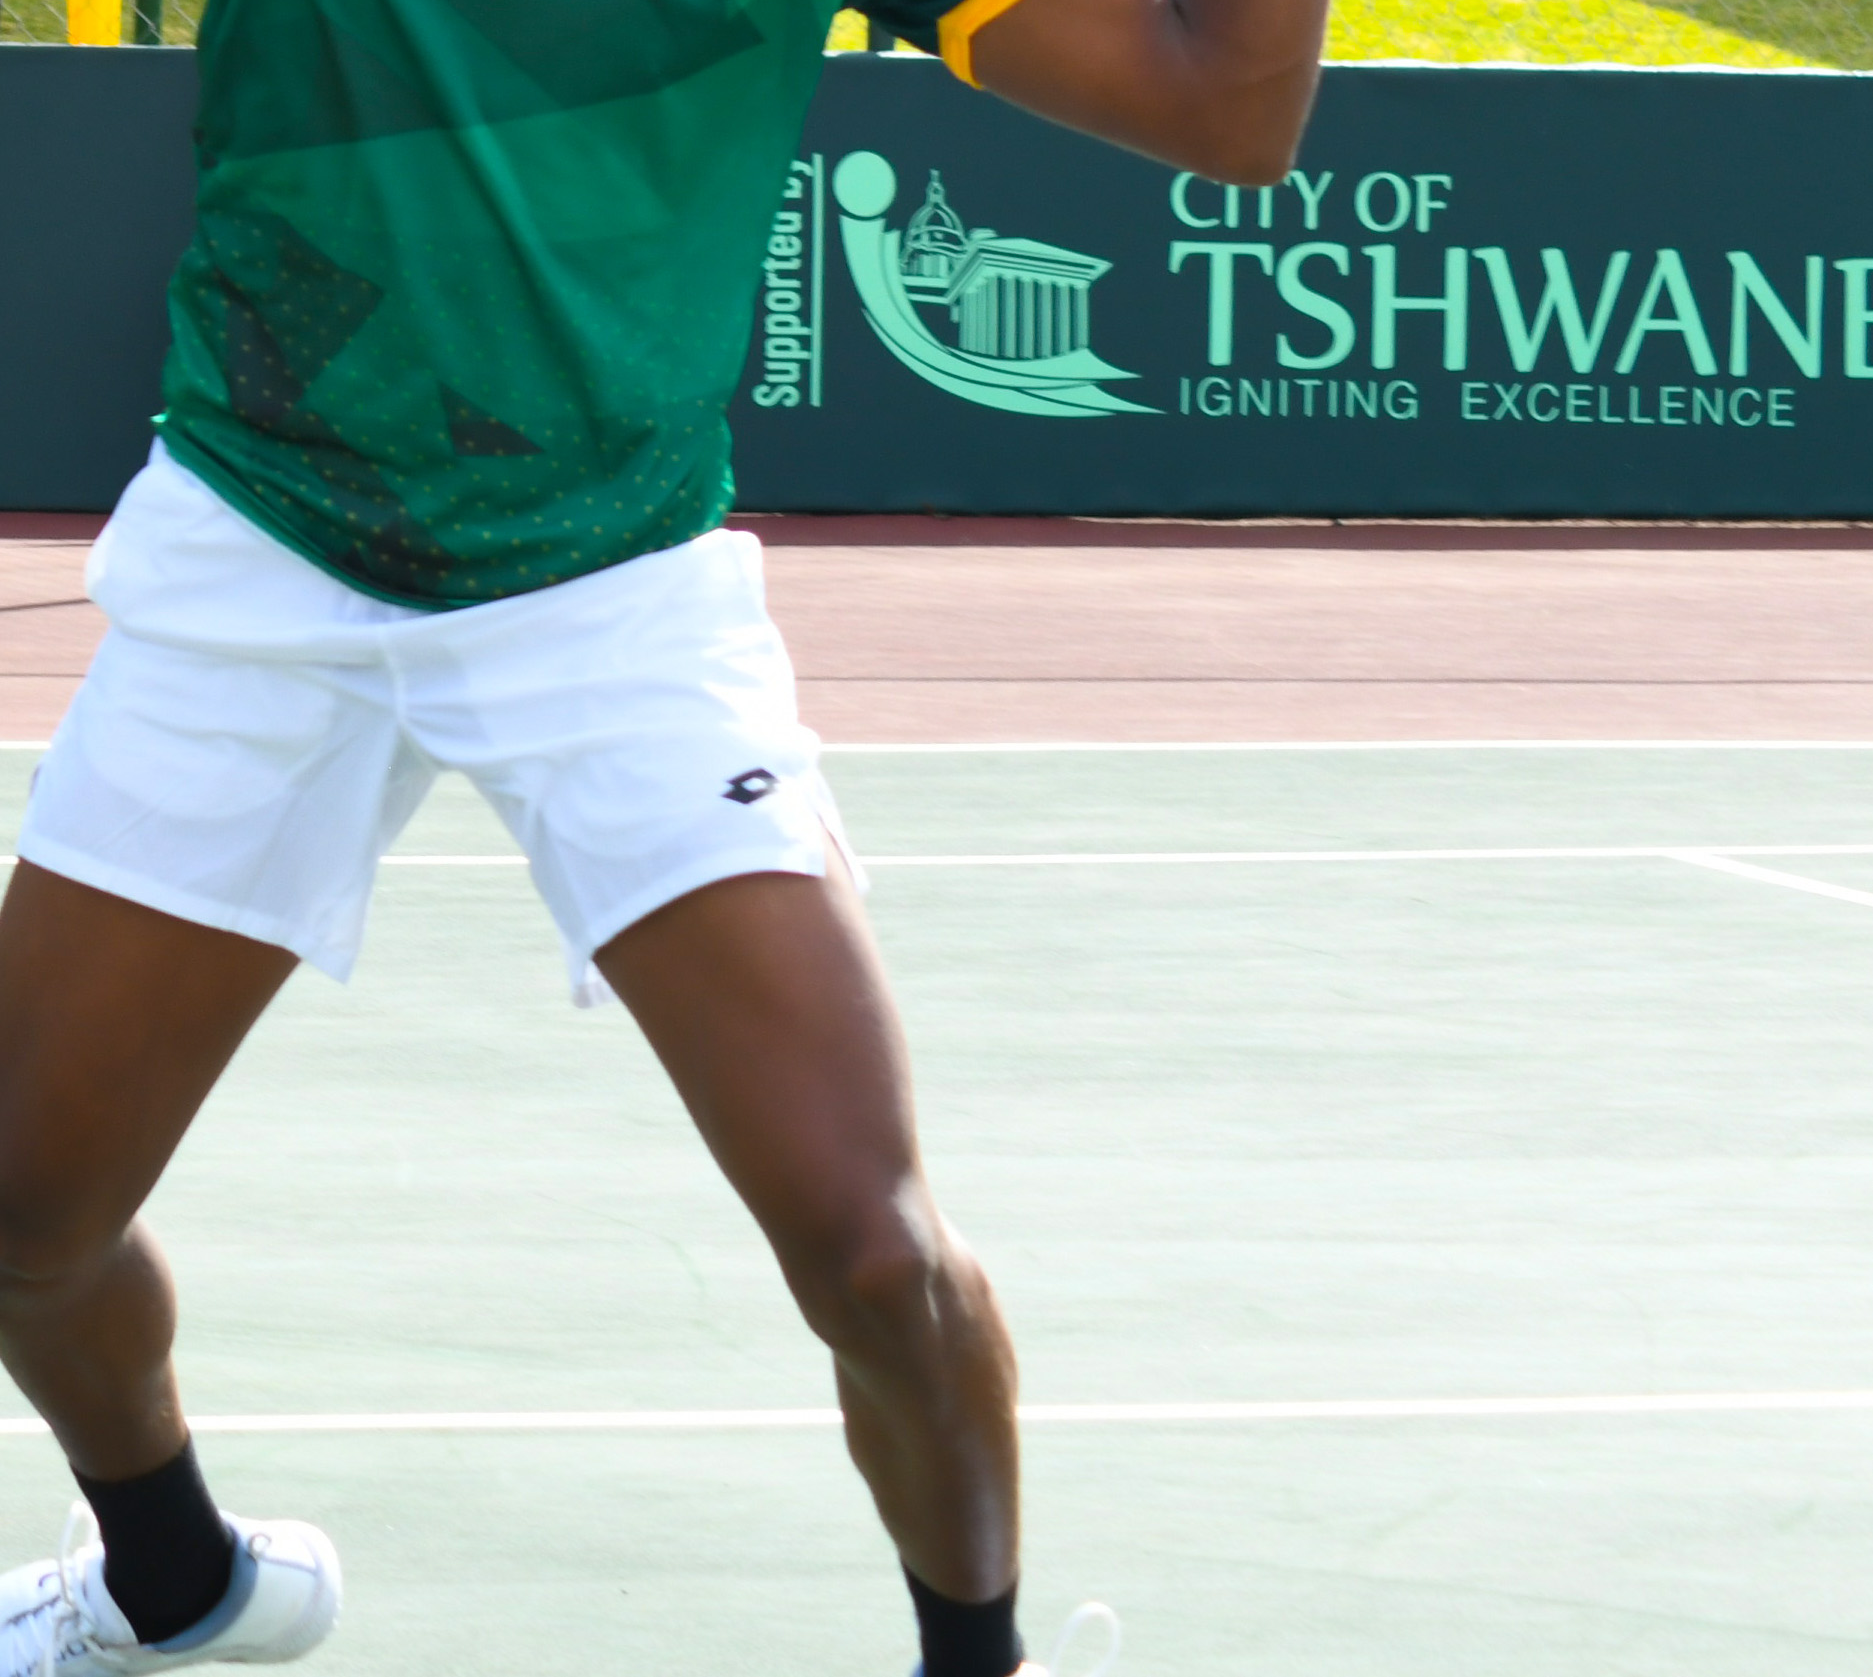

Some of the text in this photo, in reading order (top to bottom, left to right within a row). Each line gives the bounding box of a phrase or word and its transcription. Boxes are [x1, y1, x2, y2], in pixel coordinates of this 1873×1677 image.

[1353, 171, 1454, 233] OF
[1179, 376, 1796, 427] IGNITING EXCELLENCE
